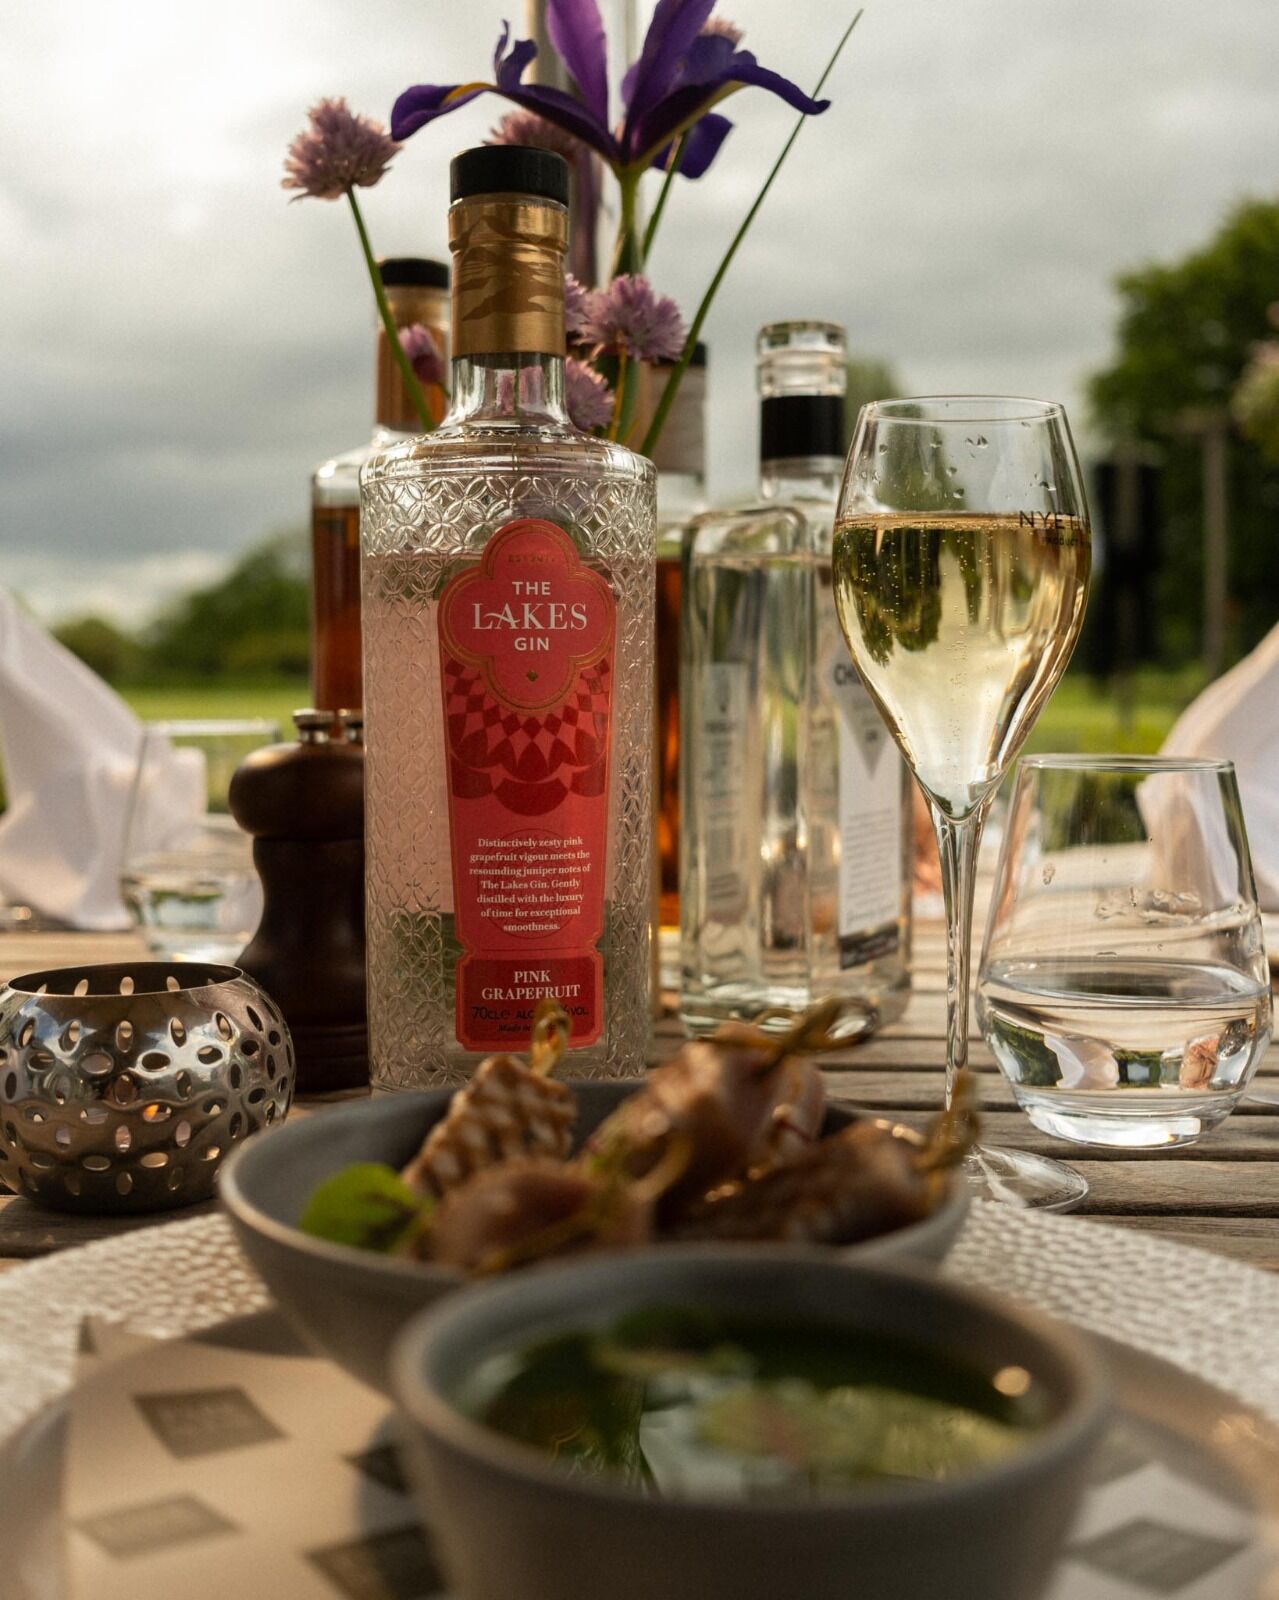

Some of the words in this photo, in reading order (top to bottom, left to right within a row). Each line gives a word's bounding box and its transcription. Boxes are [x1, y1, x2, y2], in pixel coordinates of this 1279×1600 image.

[511, 581, 551, 595] THE
[472, 602, 588, 630] LAKES
[514, 637, 550, 651] GIN
[478, 838, 537, 849] Distinctively
[539, 838, 561, 848] zesty
[563, 836, 583, 848] pink
[469, 852, 517, 864] grapefruit
[519, 852, 548, 863] vigour
[550, 851, 576, 860] meets
[577, 850, 590, 859] the
[469, 866, 521, 877] resounding
[522, 866, 557, 877] juniper
[558, 865, 581, 874] notes
[582, 863, 591, 872] of
[480, 880, 499, 889] The
[501, 880, 528, 889] Lakes
[529, 879, 550, 889] Gin.
[551, 878, 581, 889] Gently
[477, 894, 515, 904] distilled
[517, 894, 538, 903] with
[539, 893, 554, 902] the
[555, 893, 584, 903] luxury
[480, 908, 490, 917] of
[491, 908, 513, 917] time
[514, 908, 529, 917] for
[530, 906, 581, 918] exceptional
[503, 921, 561, 932] smoothness.
[513, 969, 551, 984] PINK
[481, 984, 581, 1000] GRAPEFRUIT
